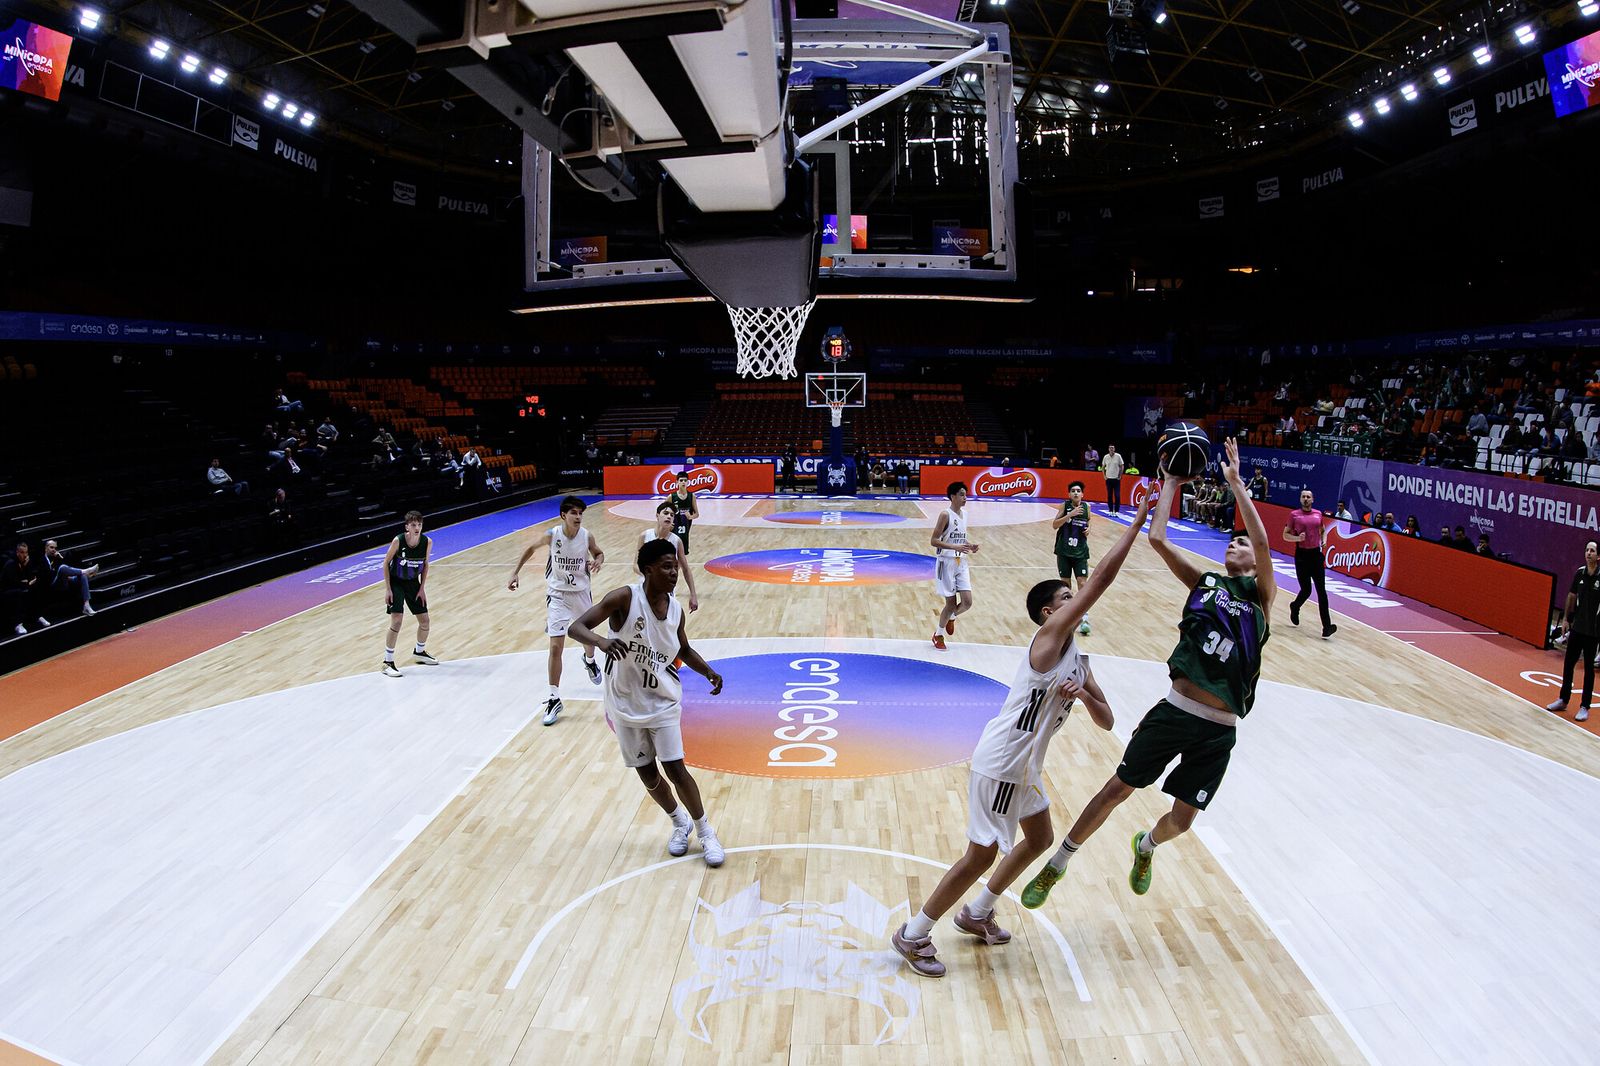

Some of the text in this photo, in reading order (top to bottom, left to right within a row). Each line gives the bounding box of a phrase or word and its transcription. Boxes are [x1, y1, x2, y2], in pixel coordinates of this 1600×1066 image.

[1450, 103, 1474, 119] PULEVA
[236, 118, 259, 135] PULEVA
[274, 137, 318, 173] PULEVA
[1302, 166, 1344, 194] PULEVA
[438, 194, 490, 216] PULEVA
[71, 323, 104, 334] endesa
[1250, 457, 1269, 468] endesa
[1388, 473, 1433, 498] DONDE
[1434, 482, 1485, 508] NACEN
[1487, 489, 1515, 514] LAS
[1067, 537, 1079, 547] 30
[566, 573, 577, 586] 12
[1202, 630, 1235, 664] 34
[642, 668, 659, 689] 10
[765, 657, 857, 769] endesa
